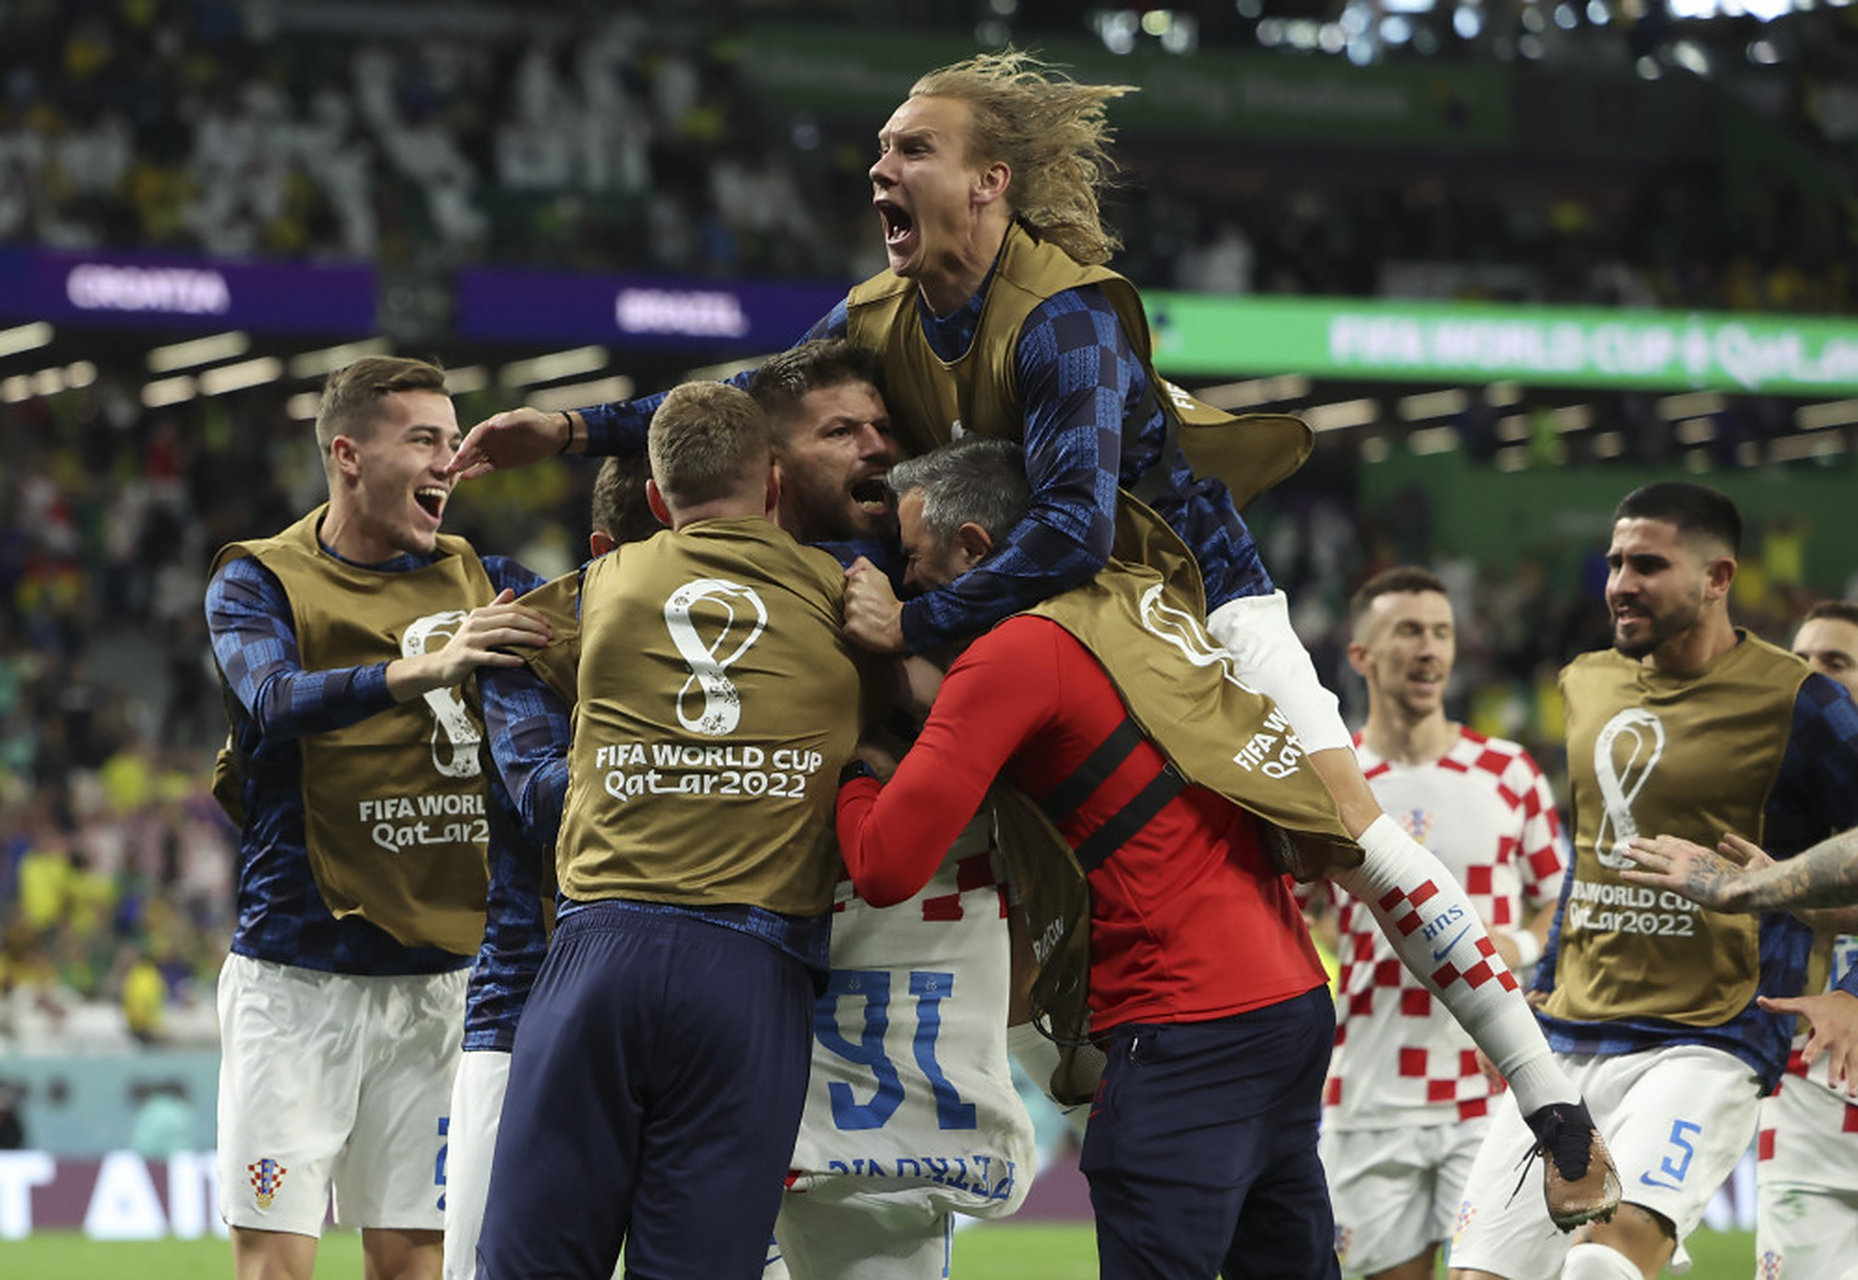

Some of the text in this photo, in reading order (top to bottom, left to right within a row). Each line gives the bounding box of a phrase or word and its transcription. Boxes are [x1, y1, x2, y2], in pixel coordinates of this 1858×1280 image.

[1329, 316, 1423, 366] FIFA
[1435, 318, 1587, 371] WORLD
[1591, 324, 1676, 375] CUP
[1233, 706, 1289, 772] FIFA W
[596, 744, 823, 773] FIFA WORLD CUP
[1261, 735, 1302, 779] Qat
[604, 769, 806, 801] Qatar2022
[359, 794, 486, 822] FIFA WORL
[372, 819, 490, 854] Qatar2
[1584, 883, 1656, 908] WORLD
[1659, 891, 1699, 911] CU
[1661, 1119, 1702, 1182] 5
